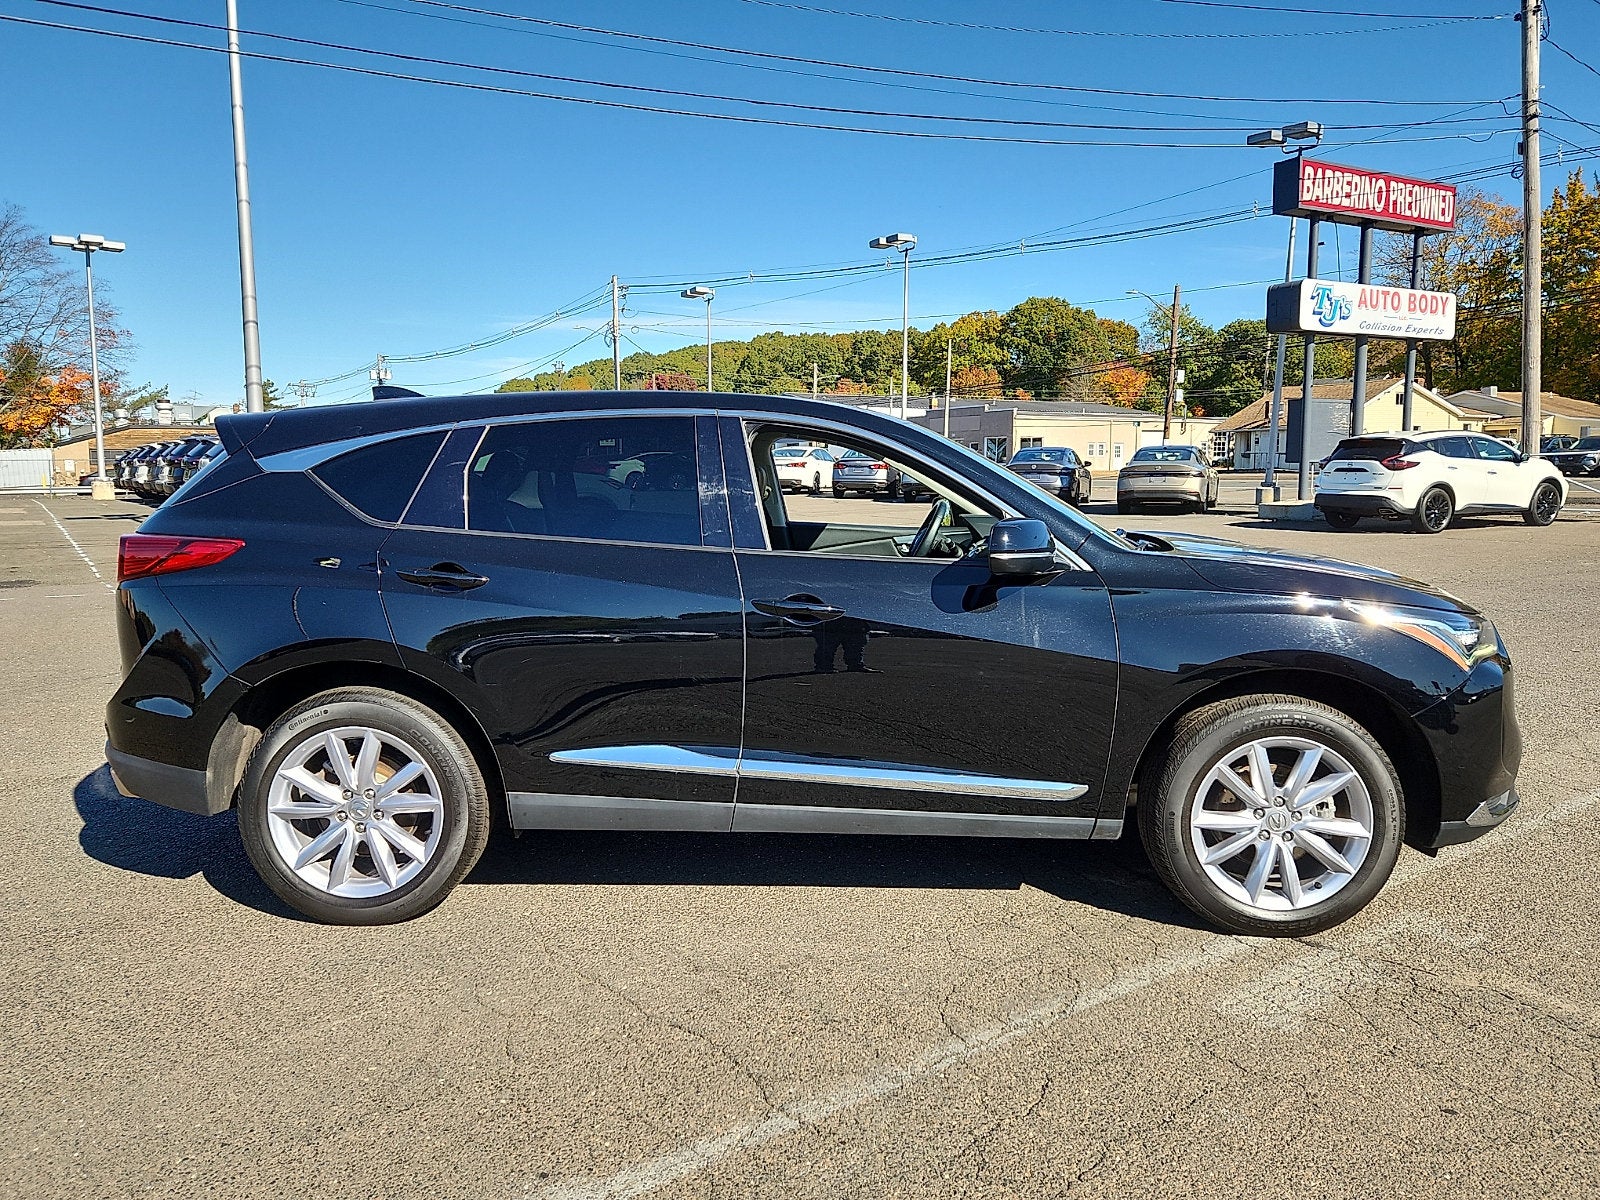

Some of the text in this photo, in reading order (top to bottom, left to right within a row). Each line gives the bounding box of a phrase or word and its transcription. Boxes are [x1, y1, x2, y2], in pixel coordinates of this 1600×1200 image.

[1302, 165, 1455, 223] BARBERINO PREOWNED
[1357, 288, 1450, 316] AUTO BODY
[1359, 320, 1446, 336] Collision Experts
